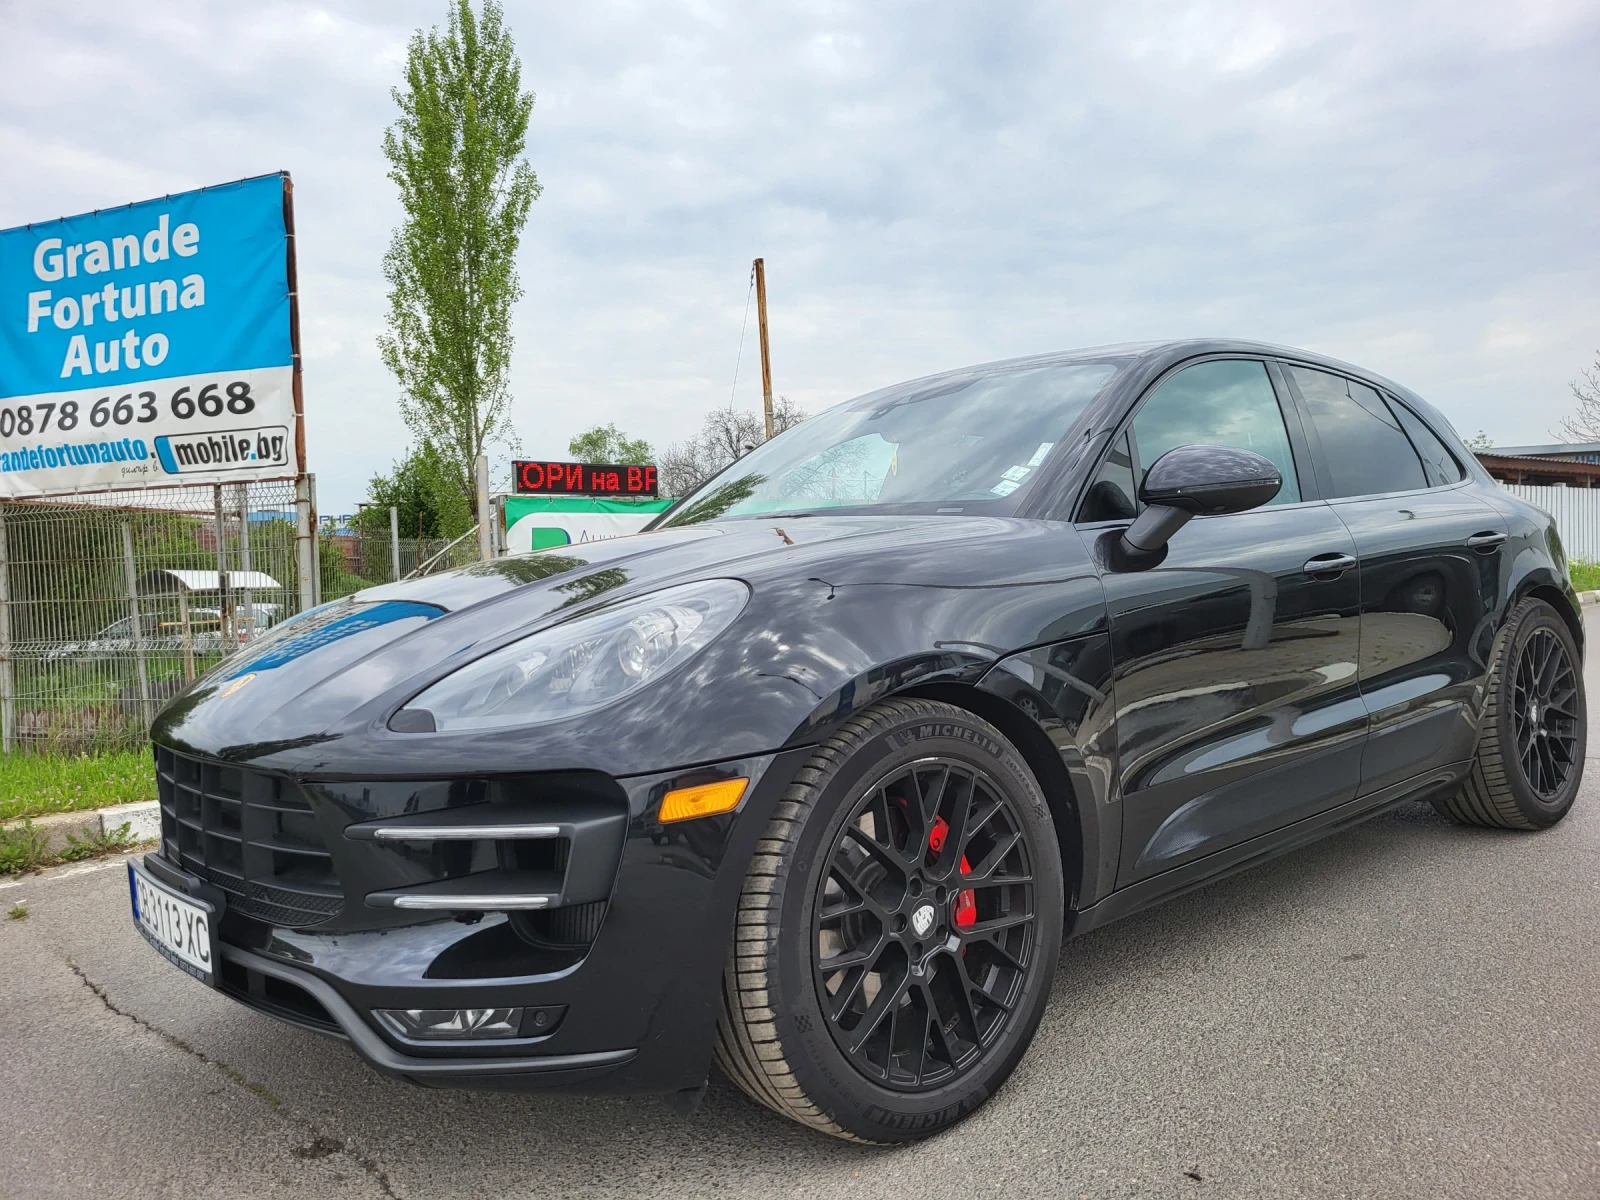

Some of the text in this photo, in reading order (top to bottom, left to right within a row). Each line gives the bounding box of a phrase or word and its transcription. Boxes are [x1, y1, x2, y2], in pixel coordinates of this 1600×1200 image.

[33, 213, 200, 282] Grande
[27, 273, 206, 333] Fortuna
[60, 328, 170, 378] Auto
[0, 381, 255, 438] 0878 663 668
[0, 431, 284, 473] andefortunauto. mobile.bg
[517, 462, 583, 490] ОРИ
[591, 472, 620, 491] на
[919, 725, 1000, 755] MICHELIN
[870, 1101, 960, 1129] MICHELIN
